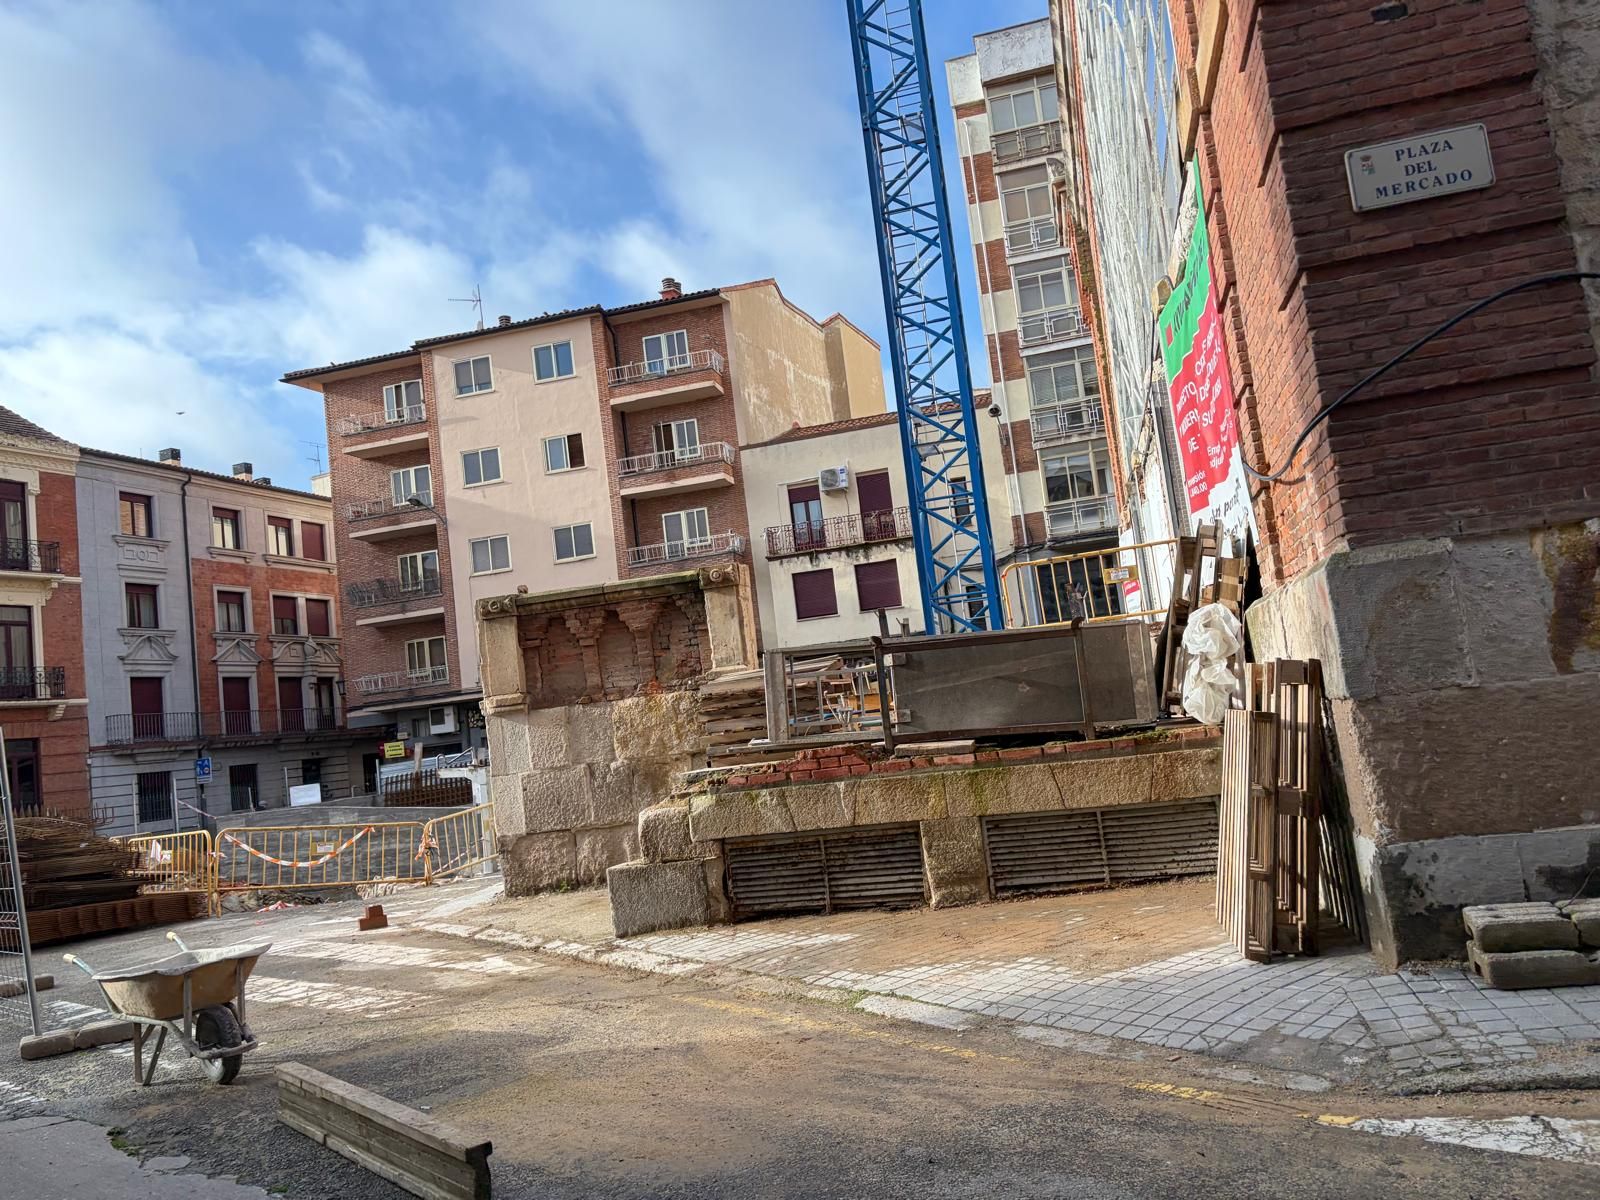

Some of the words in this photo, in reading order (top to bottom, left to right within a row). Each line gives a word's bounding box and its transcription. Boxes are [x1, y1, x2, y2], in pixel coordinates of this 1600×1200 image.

[1395, 139, 1454, 162] PLAZA
[1404, 160, 1437, 177] DEL
[1375, 168, 1473, 199] MERCADO
